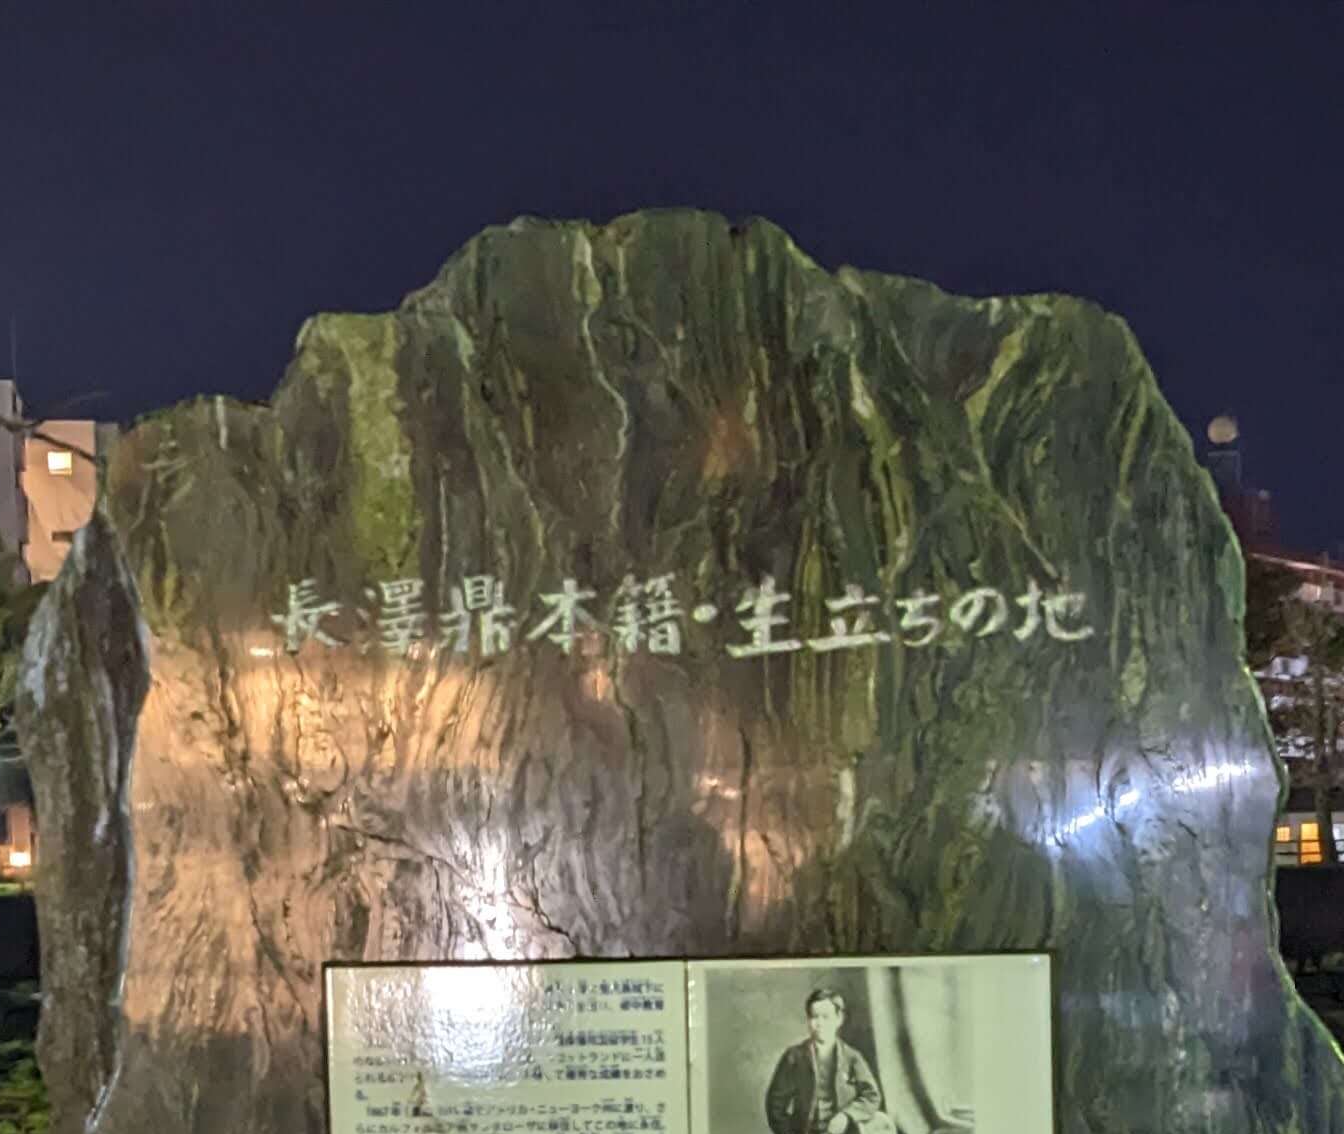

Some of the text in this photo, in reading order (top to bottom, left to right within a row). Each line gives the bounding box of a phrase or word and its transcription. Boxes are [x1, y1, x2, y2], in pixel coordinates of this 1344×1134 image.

[272, 573, 1094, 658] 長澤鼎本籍・生立ちの地
